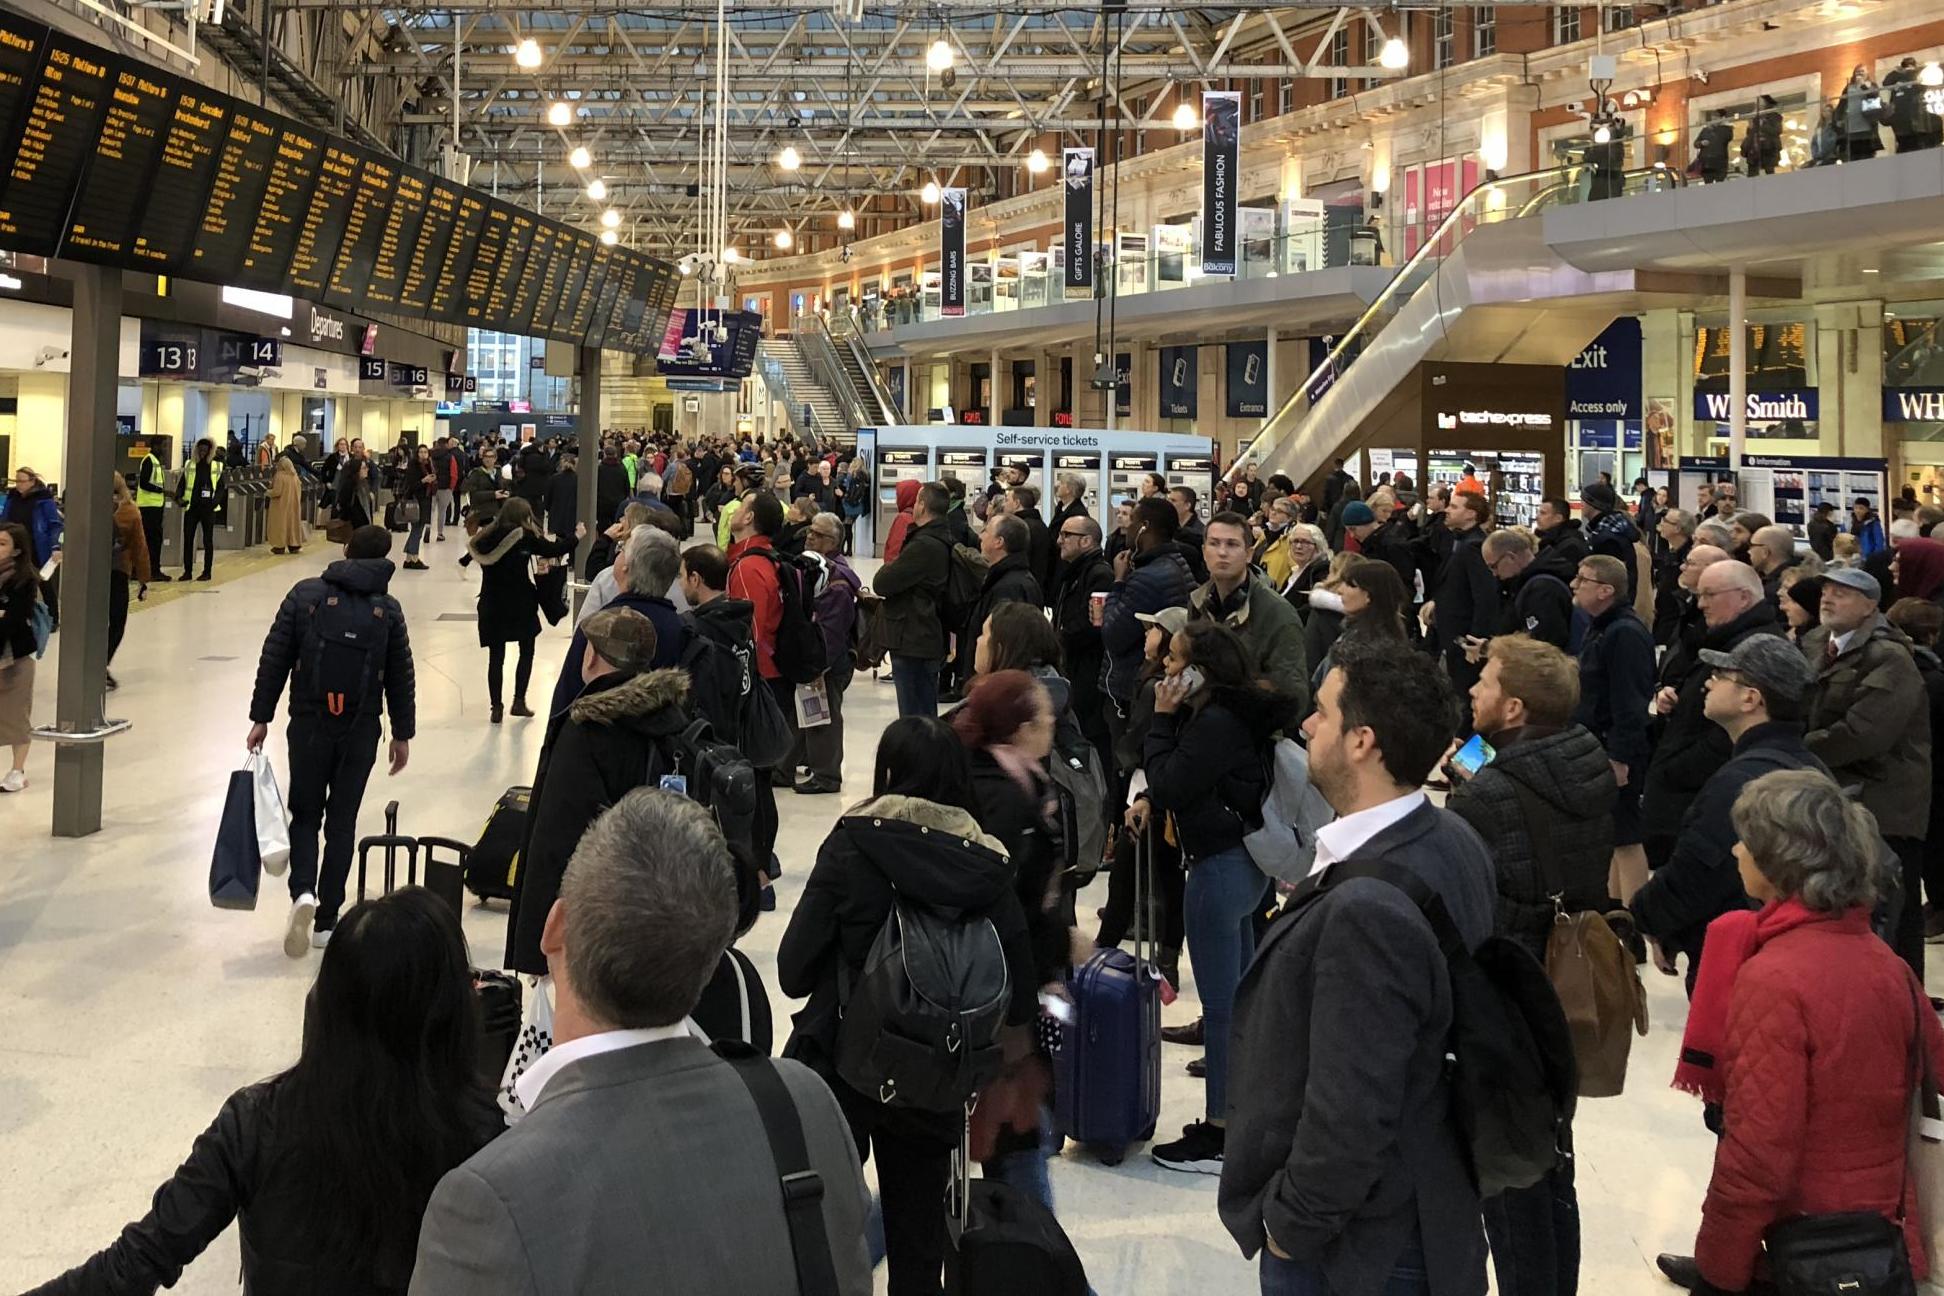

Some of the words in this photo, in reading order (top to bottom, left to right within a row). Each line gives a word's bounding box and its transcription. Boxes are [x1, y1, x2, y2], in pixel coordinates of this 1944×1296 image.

[1216, 155, 1225, 198] FASHION
[1215, 201, 1224, 251] FABULOUS
[311, 306, 343, 341] Departures
[157, 347, 181, 369] 13
[251, 342, 273, 361] 14
[366, 362, 382, 376] 15
[411, 369, 425, 382] 16
[450, 377, 461, 388] 17
[1170, 404, 1188, 414] Tickets
[1239, 402, 1264, 413] Entrance
[1570, 400, 1604, 413] Access
[1605, 400, 1627, 416] only
[1706, 393, 1807, 419] WSmith
[1460, 411, 1552, 426] techexpress
[996, 433, 1060, 445] Self-service
[1063, 435, 1098, 446] tickets
